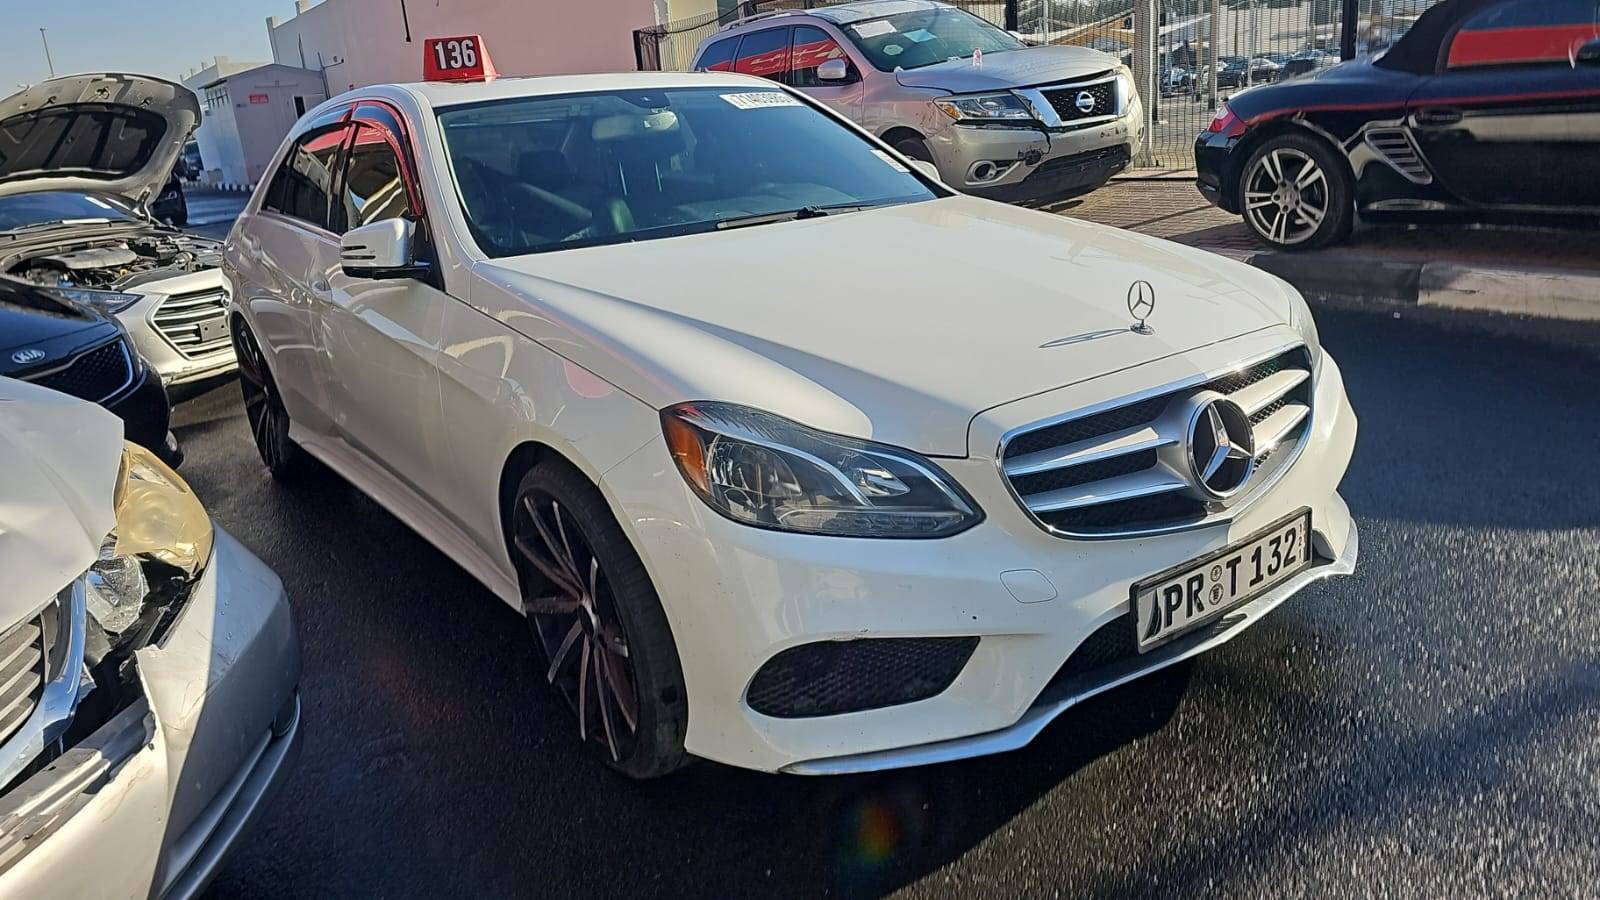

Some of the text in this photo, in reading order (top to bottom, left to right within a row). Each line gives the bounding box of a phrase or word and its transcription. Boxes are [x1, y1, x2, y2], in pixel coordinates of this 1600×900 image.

[435, 39, 476, 69] 136
[12, 350, 45, 363] KIA
[1163, 528, 1296, 627] PR T 132
